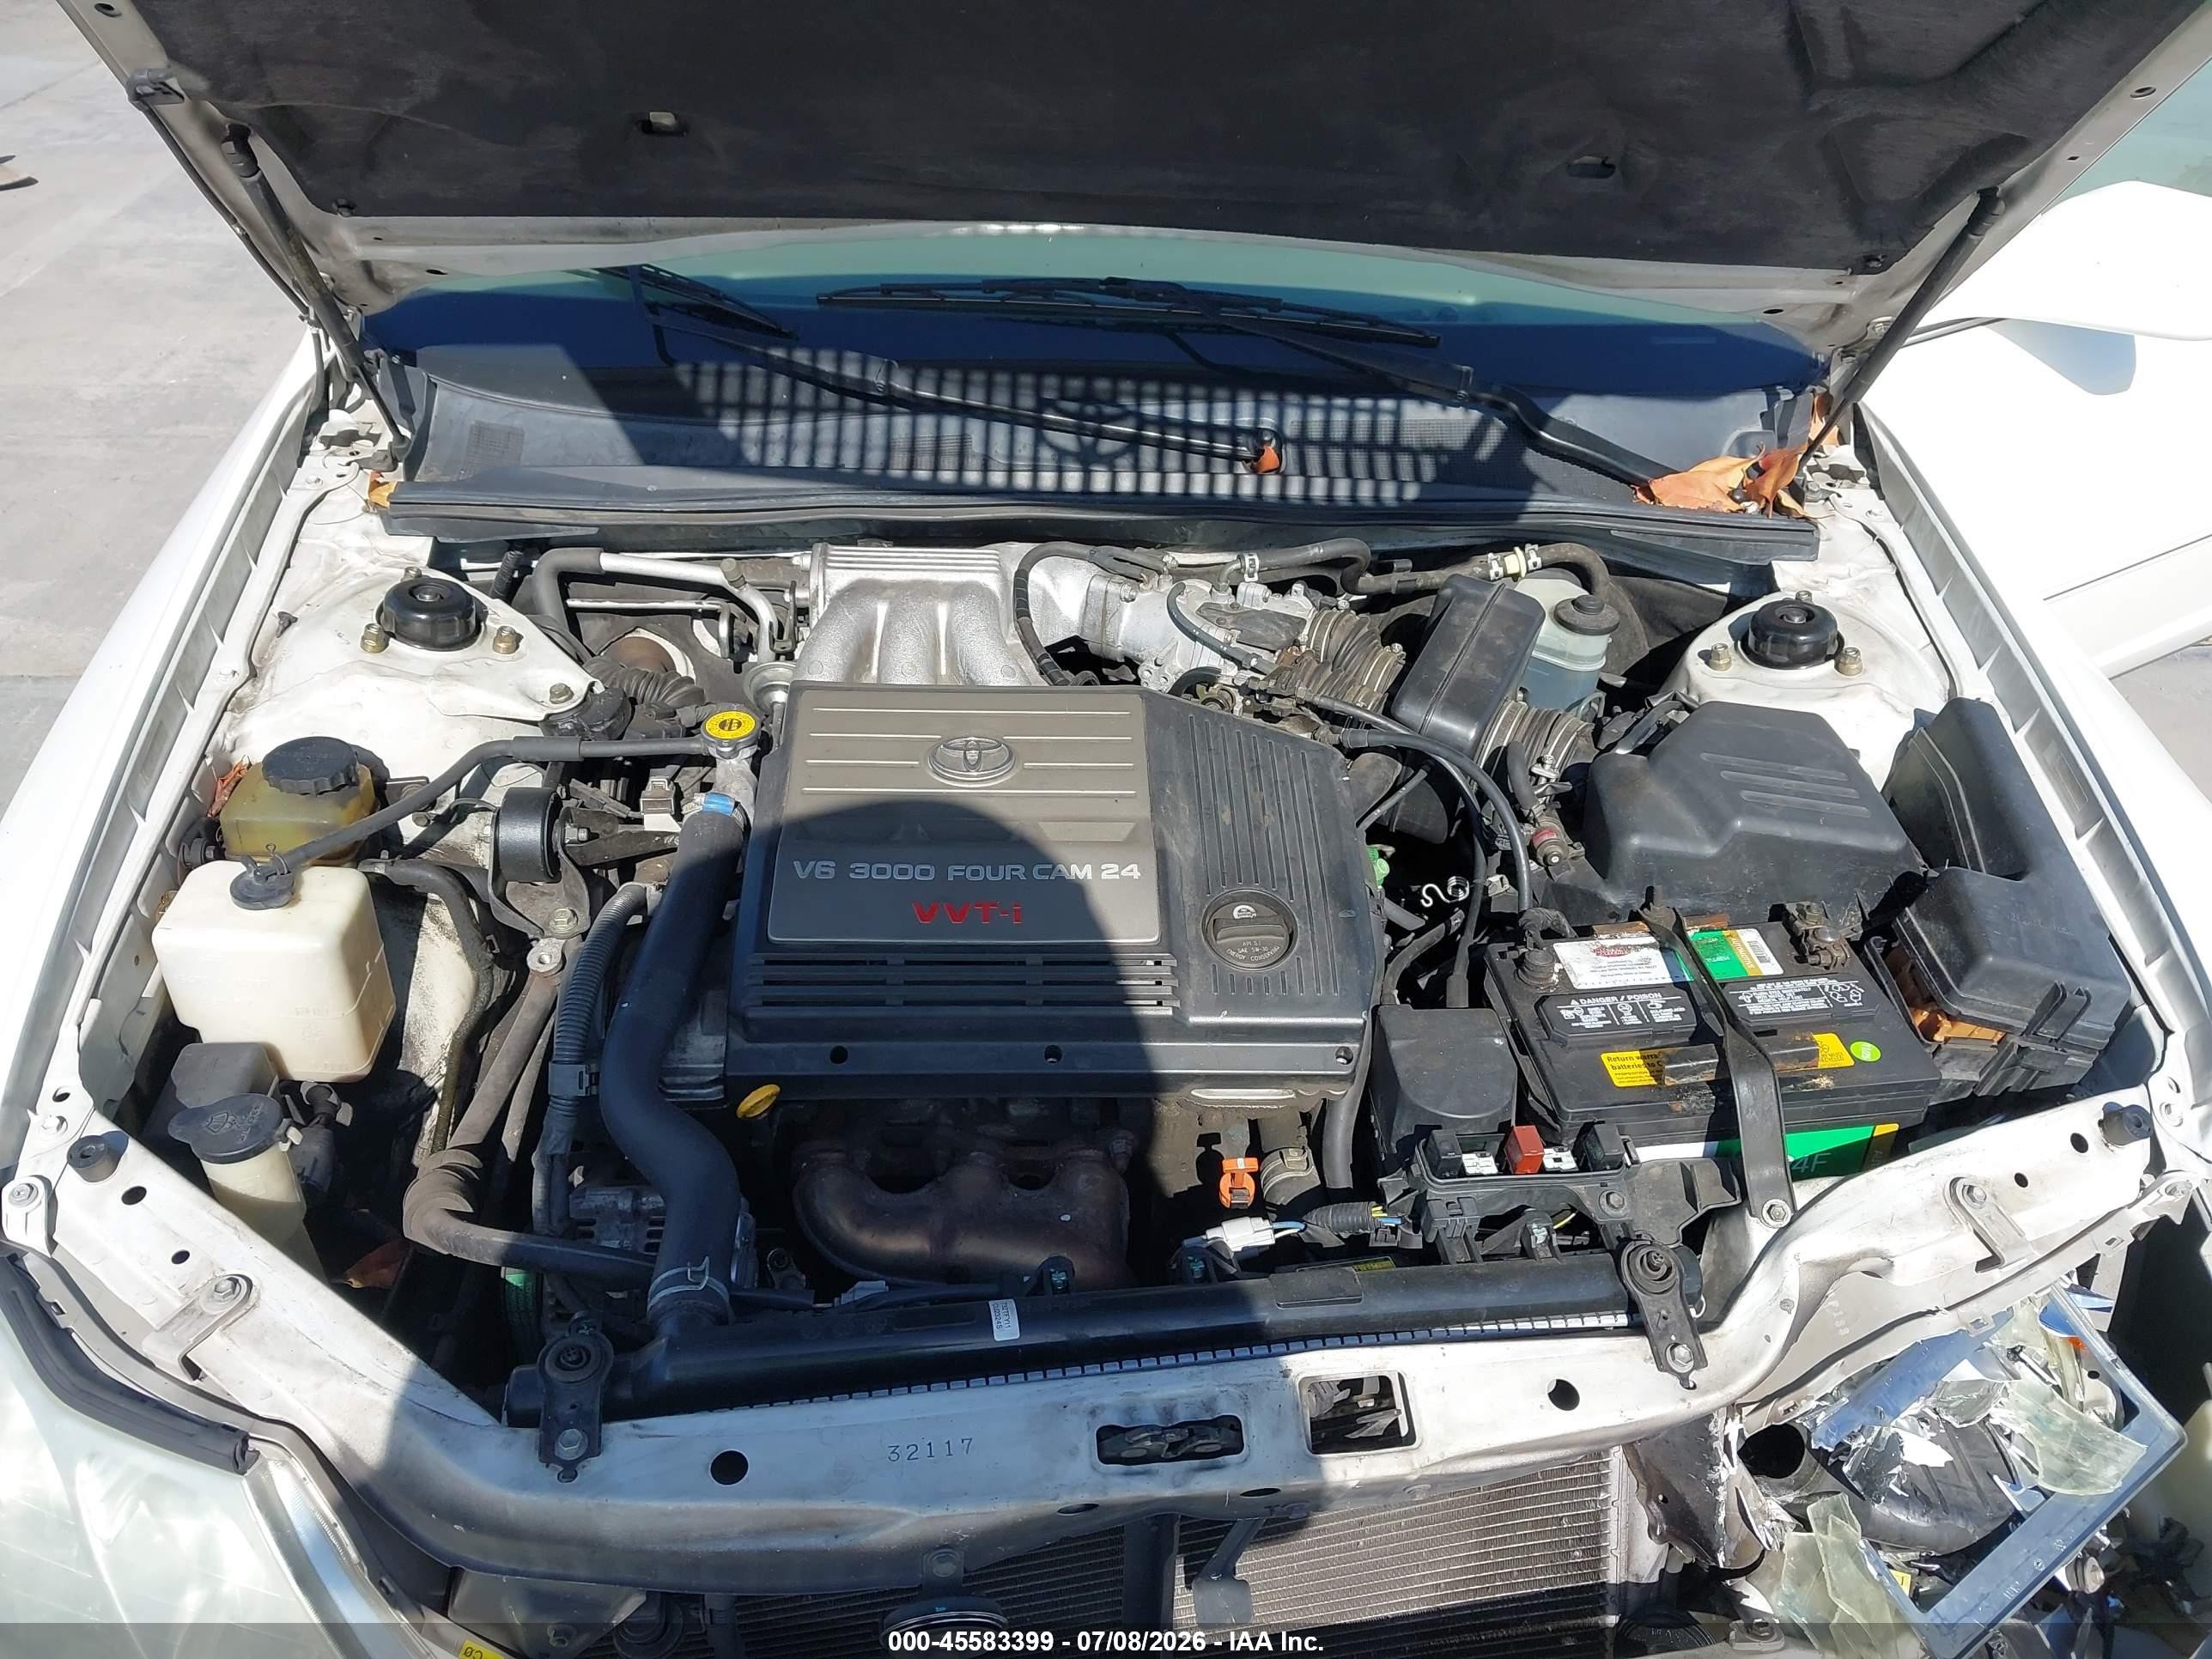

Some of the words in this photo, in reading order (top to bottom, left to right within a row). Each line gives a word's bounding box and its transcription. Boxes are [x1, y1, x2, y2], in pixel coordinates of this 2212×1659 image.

[793, 860, 837, 879] V6
[849, 861, 936, 880] 3000
[947, 864, 1028, 881] FOUR
[1031, 863, 1093, 880] CAM
[1100, 862, 1141, 880] 24
[912, 901, 1023, 924] VVT-i
[1579, 996, 1619, 1006] DANGER
[1626, 992, 1662, 1002] POISON
[887, 1437, 973, 1462] 32117
